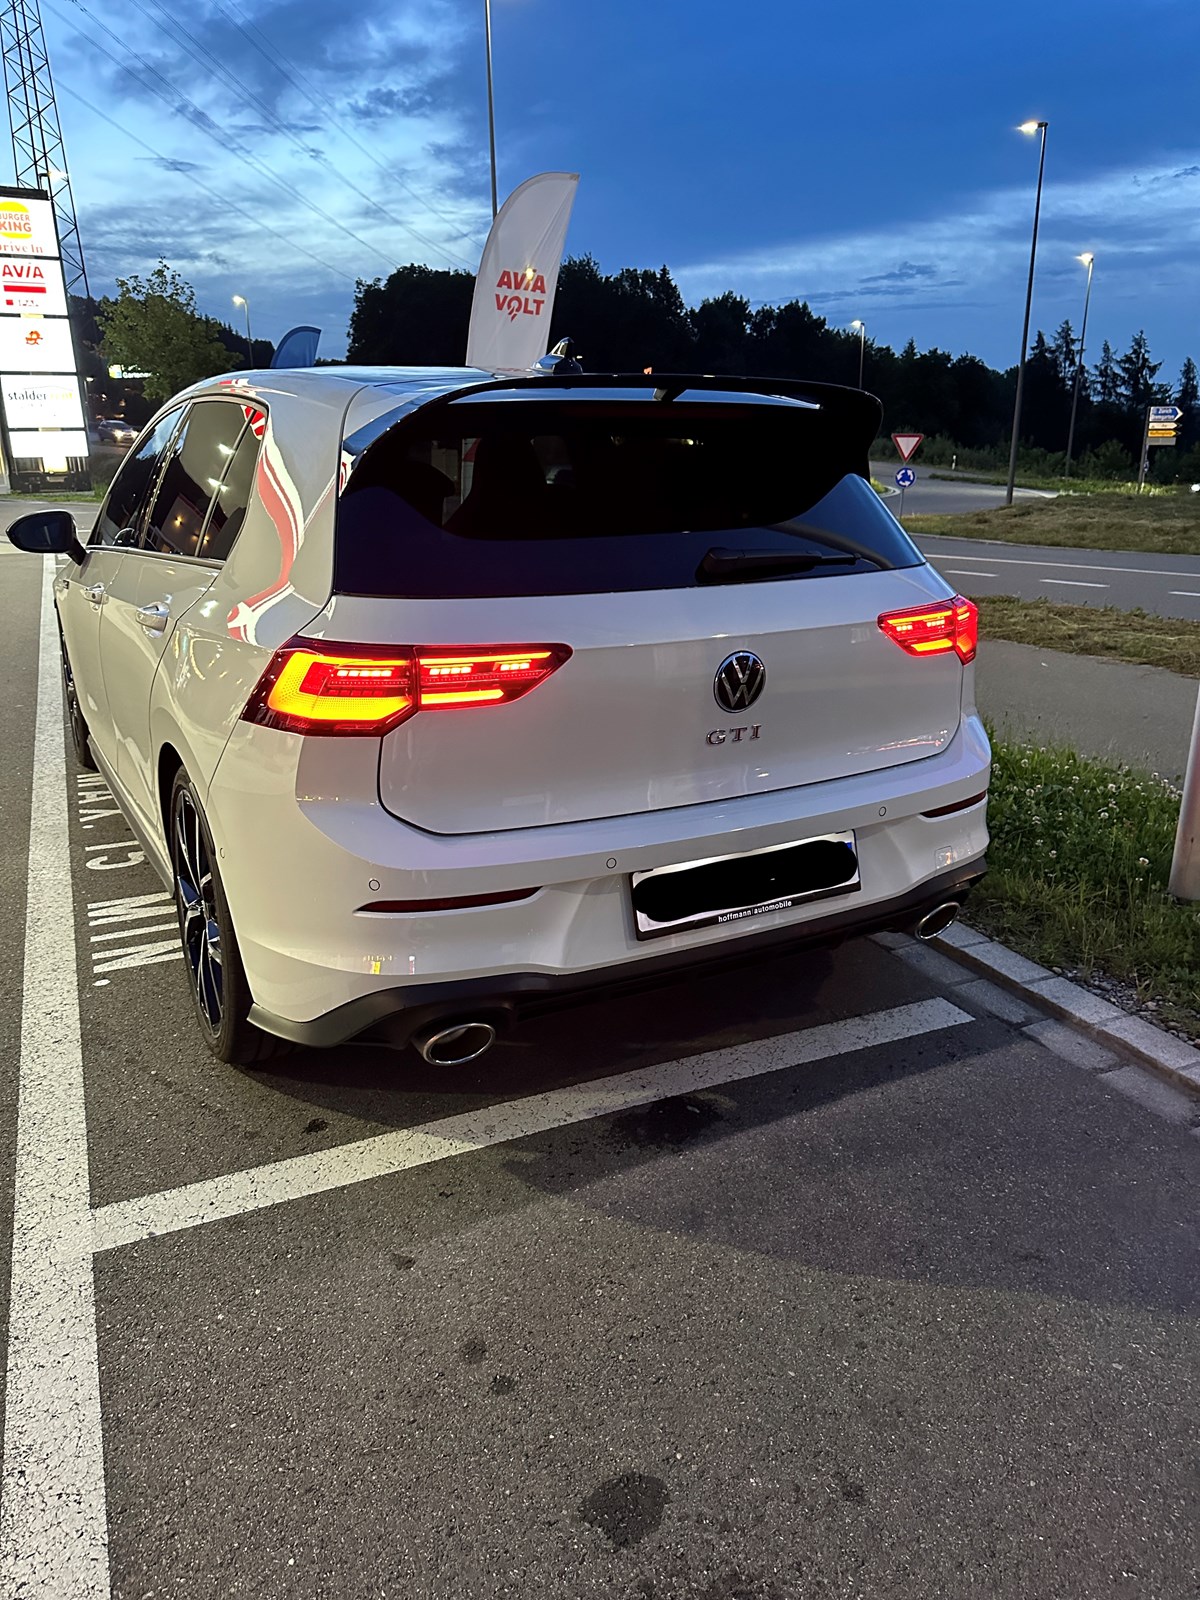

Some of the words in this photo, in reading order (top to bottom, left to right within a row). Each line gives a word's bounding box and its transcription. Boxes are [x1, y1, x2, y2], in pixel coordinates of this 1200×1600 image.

[0, 212, 31, 221] URGER
[0, 221, 32, 232] KING
[0, 241, 28, 252] rive
[2, 262, 44, 279] AVIA
[496, 269, 547, 294] AVIA
[494, 293, 546, 322] VOLT
[8, 390, 47, 401] stalder
[705, 723, 762, 745] GTI
[718, 910, 752, 923] hoffmann
[753, 900, 792, 915] automobile
